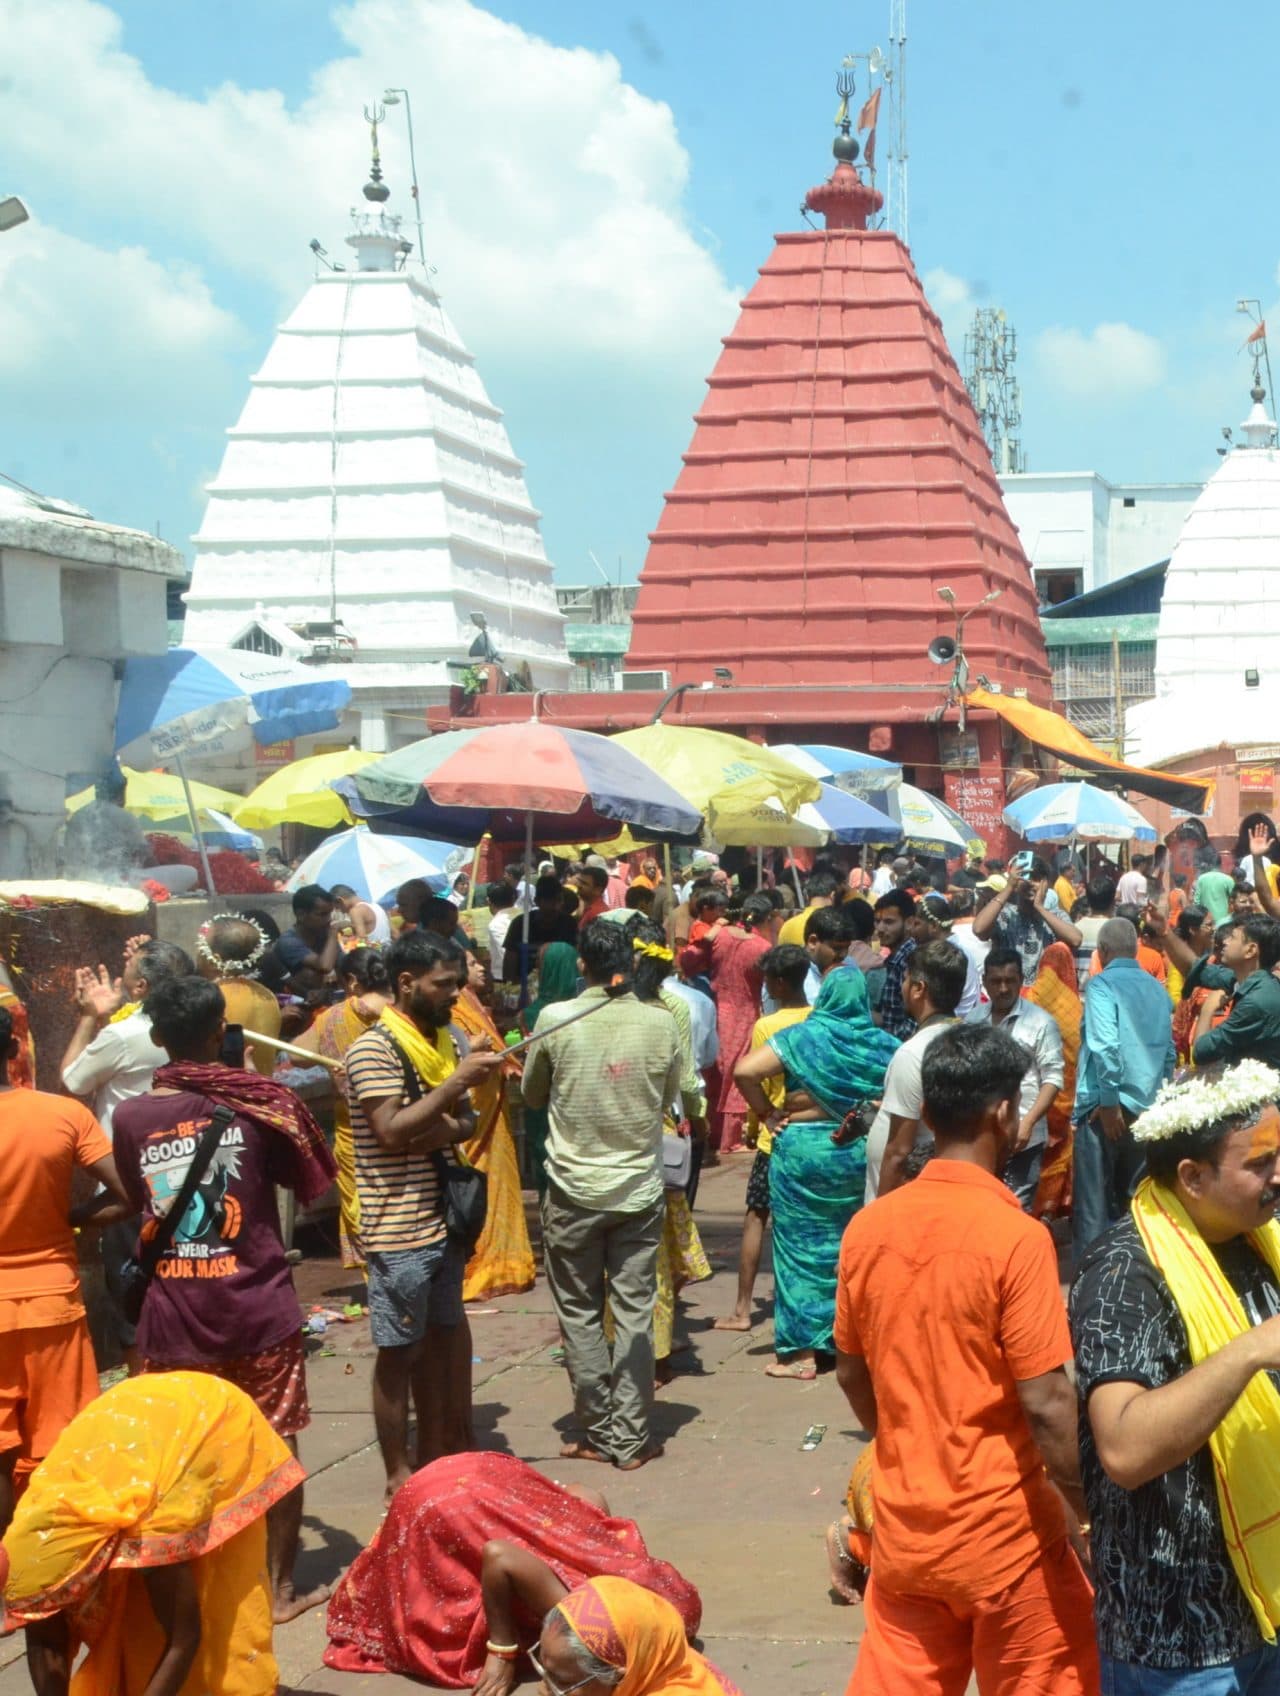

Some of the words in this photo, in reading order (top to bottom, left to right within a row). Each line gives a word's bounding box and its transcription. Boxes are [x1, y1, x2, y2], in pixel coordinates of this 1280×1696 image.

[176, 1120, 197, 1138] BE
[147, 1137, 196, 1163] GOOD
[176, 1243, 209, 1258] WEAR
[156, 1258, 194, 1279] OUR
[196, 1255, 240, 1278] MASK
